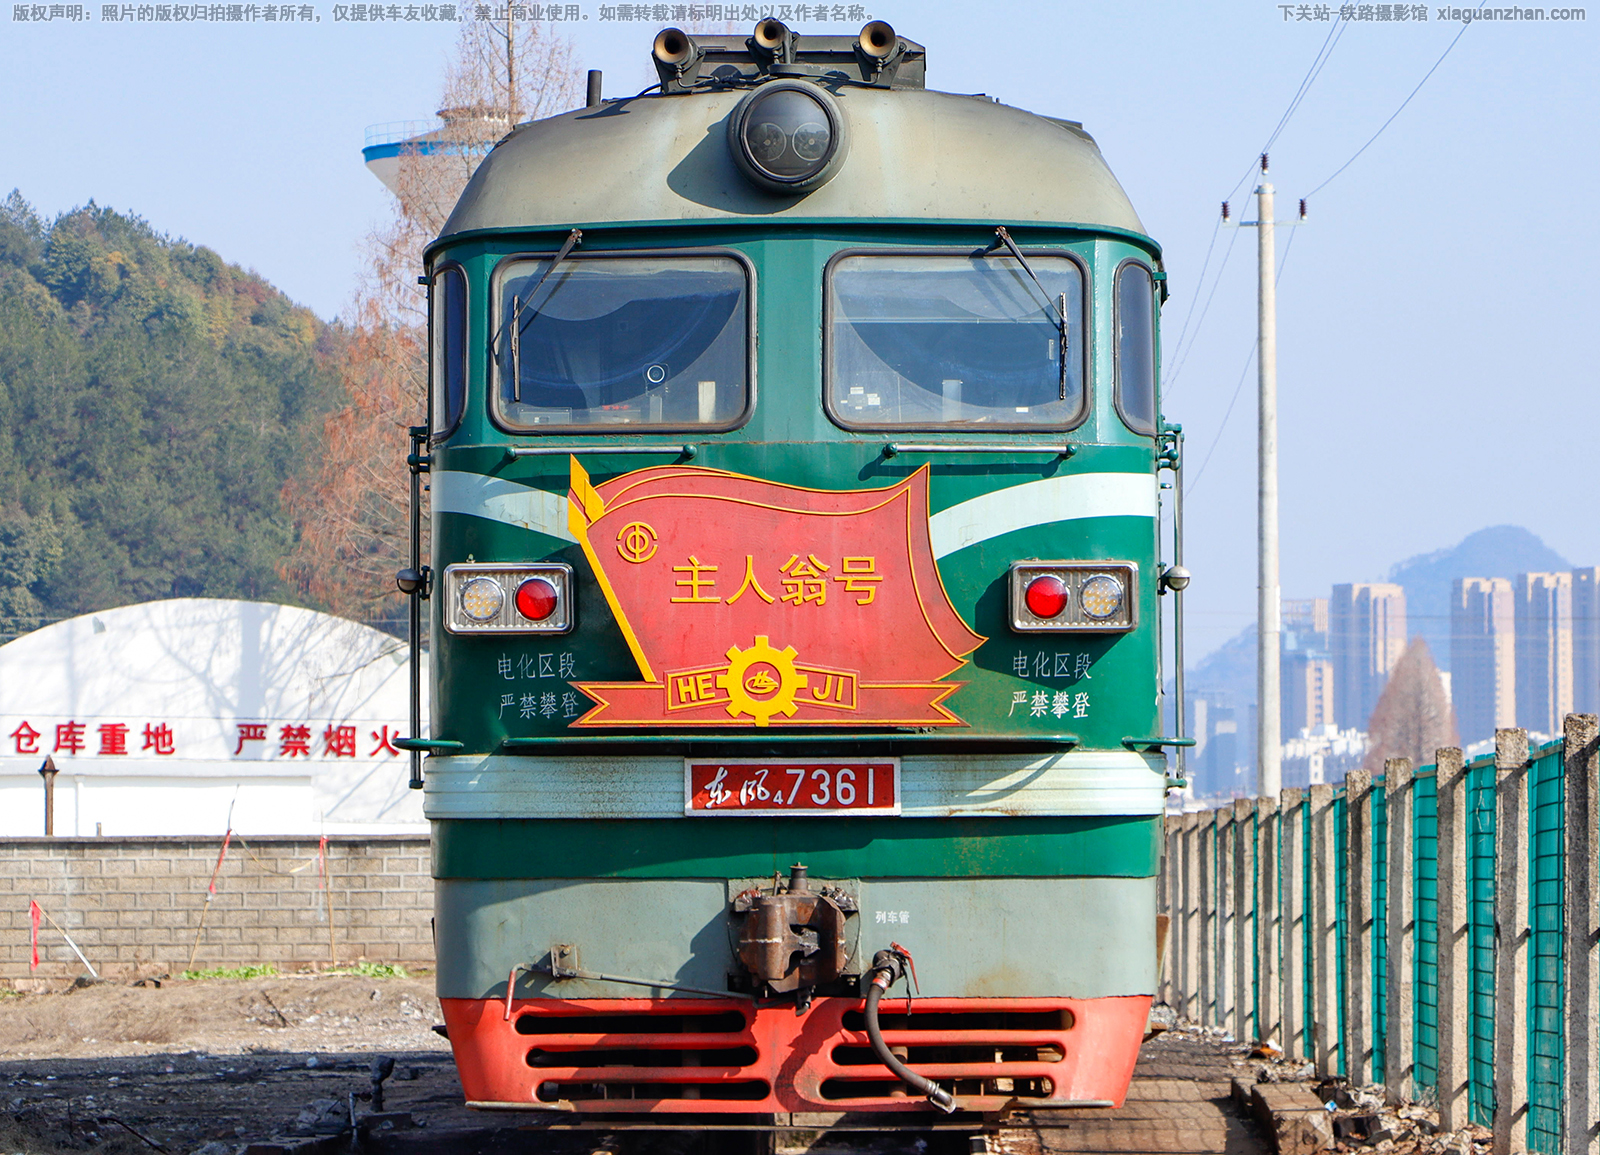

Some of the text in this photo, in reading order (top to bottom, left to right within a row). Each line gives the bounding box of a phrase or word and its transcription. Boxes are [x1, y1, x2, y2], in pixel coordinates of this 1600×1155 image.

[670, 554, 883, 606] 主人翁号
[498, 652, 577, 680] 电化区段
[1013, 650, 1092, 679] 电化区段
[677, 674, 844, 703] HE JI
[498, 691, 579, 720] 严禁攀登
[1008, 690, 1091, 719] 严禁攀登
[9, 720, 400, 757] 仓库重地 严禁烟火
[875, 910, 910, 924] 列车管
